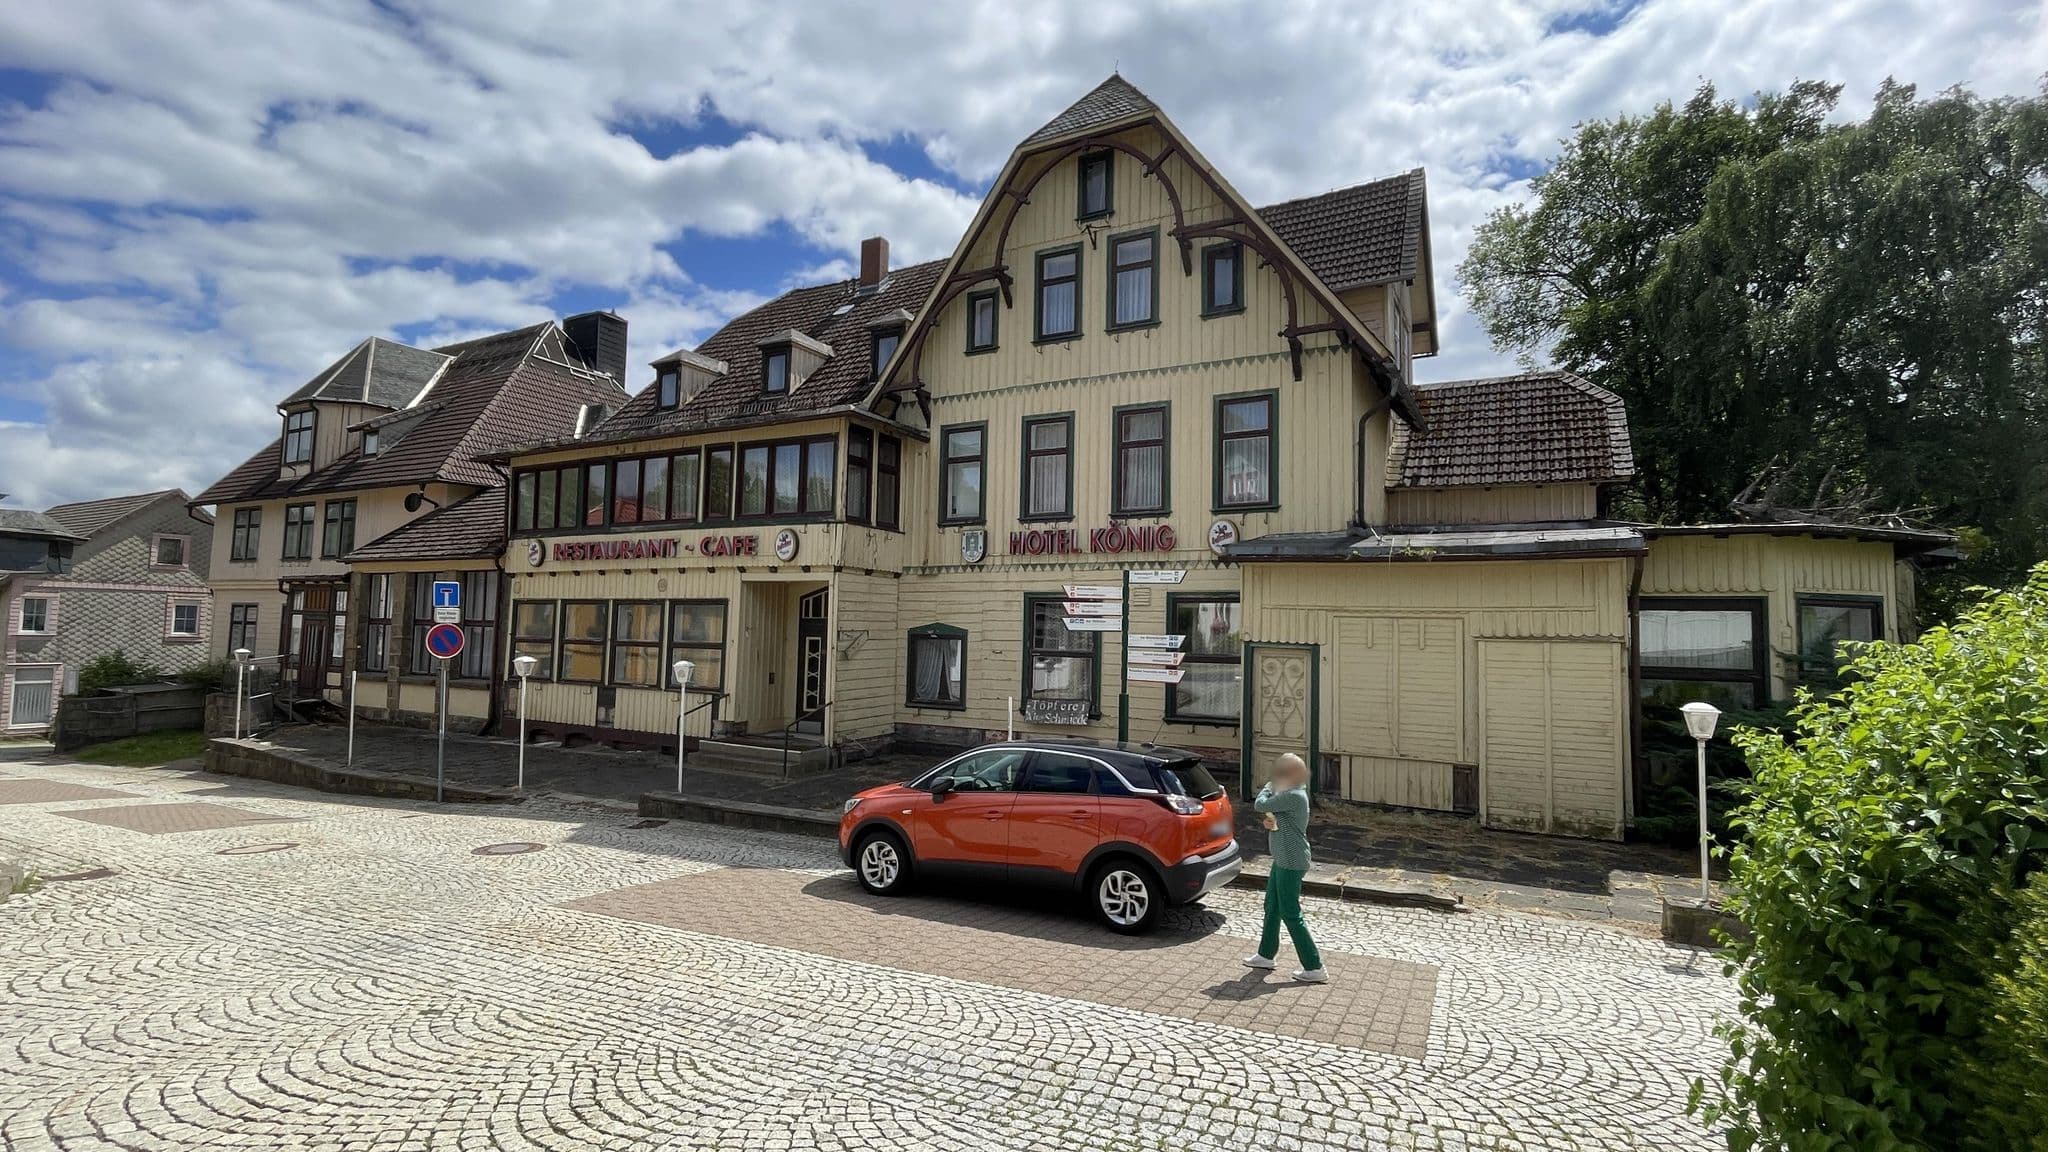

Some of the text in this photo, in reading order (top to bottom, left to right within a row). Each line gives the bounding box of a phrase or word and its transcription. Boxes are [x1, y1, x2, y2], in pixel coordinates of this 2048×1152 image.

[552, 538, 680, 561] RESTAURANT
[700, 535, 759, 557] CAFE
[1009, 529, 1083, 555] HOTEL
[1090, 520, 1177, 554] KÖNIG
